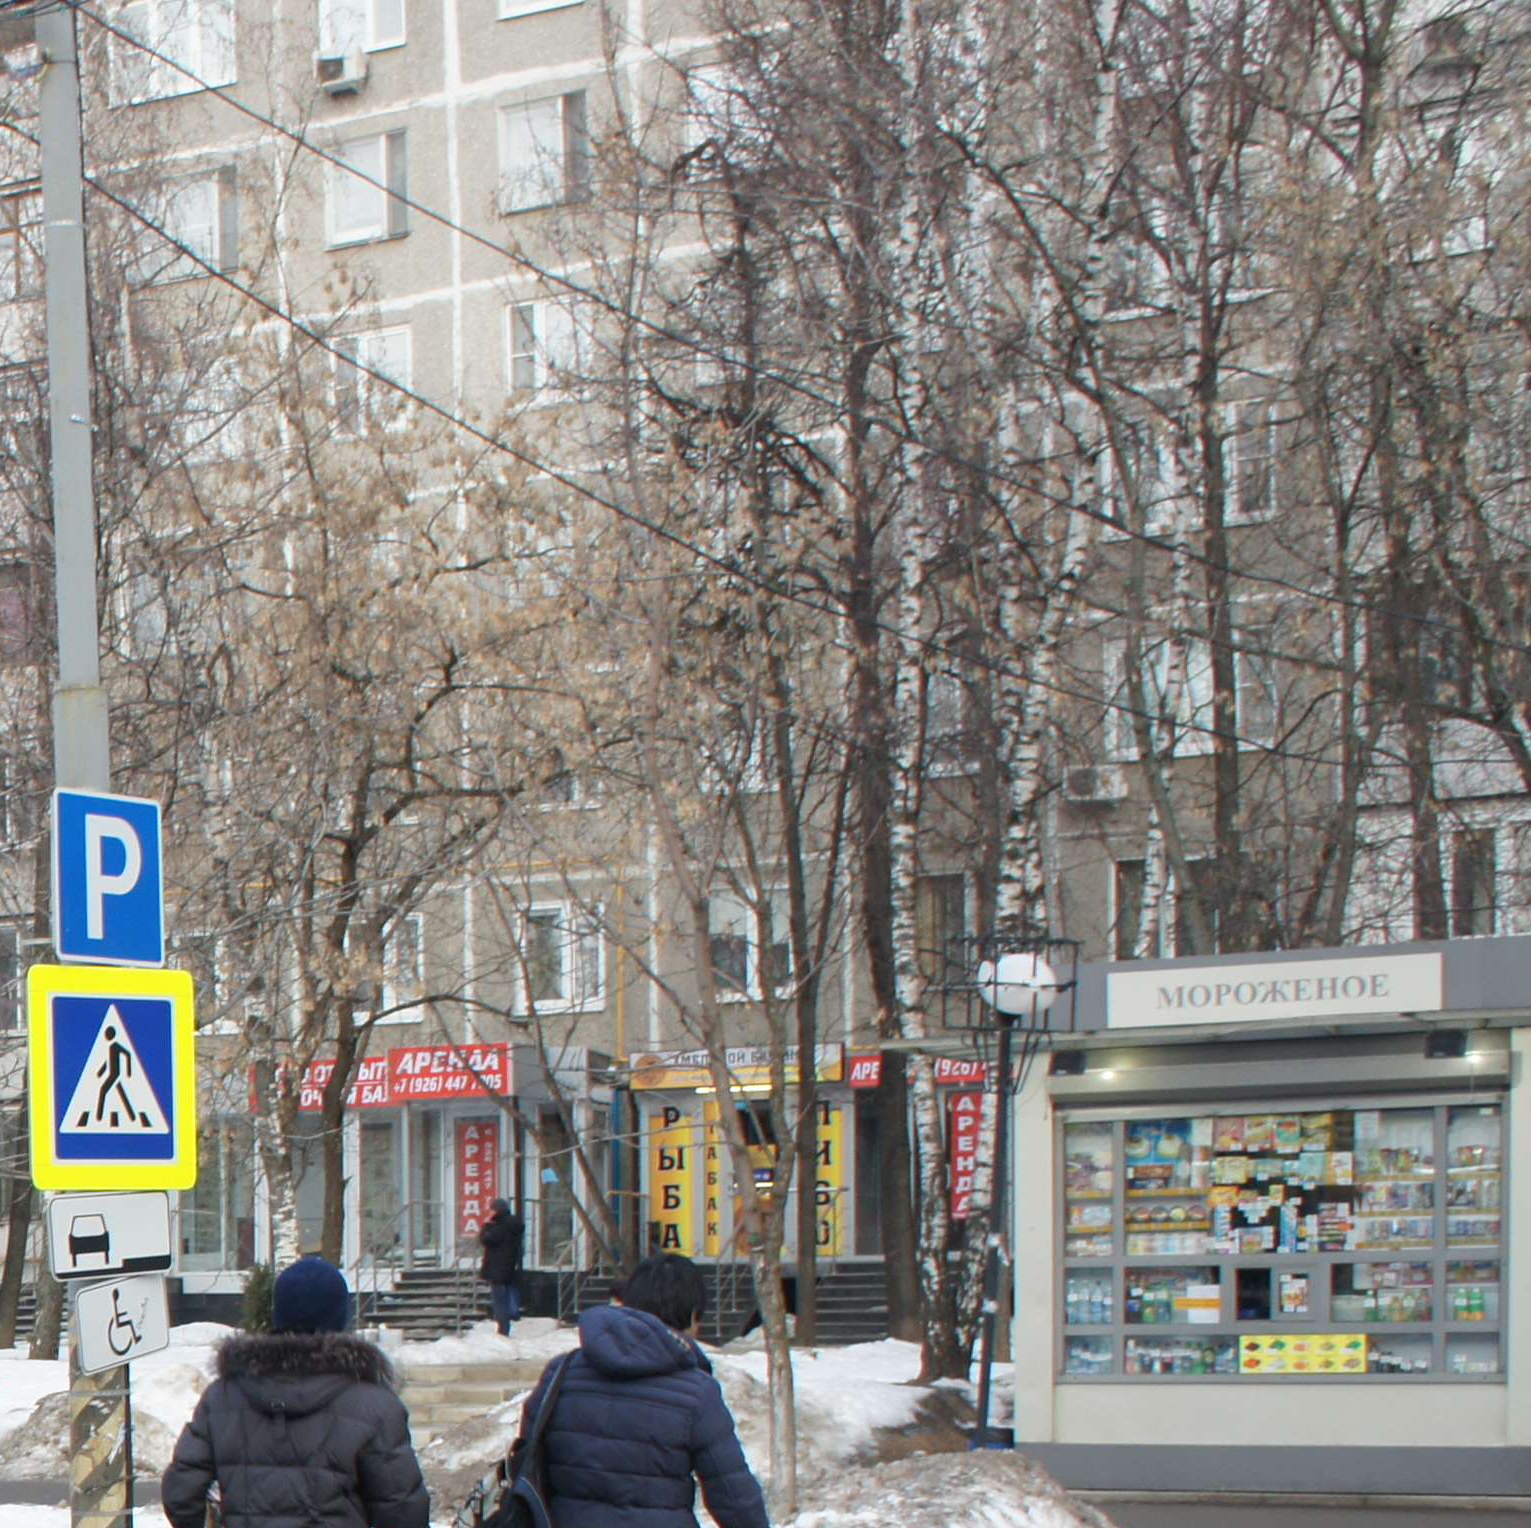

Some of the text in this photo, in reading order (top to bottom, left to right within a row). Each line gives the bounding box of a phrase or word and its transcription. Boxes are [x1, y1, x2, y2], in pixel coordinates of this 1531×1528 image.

[85, 813, 142, 939] P
[1155, 973, 1390, 1009] МОРОЖЕНОЕ
[395, 1050, 500, 1075] АРЕНДА
[409, 1077, 442, 1094] (926)
[445, 1076, 468, 1091] 447
[463, 1126, 481, 1232] АРЕНДА
[657, 1105, 686, 1249] РЫБА
[955, 1096, 975, 1212] АРЕНДА
